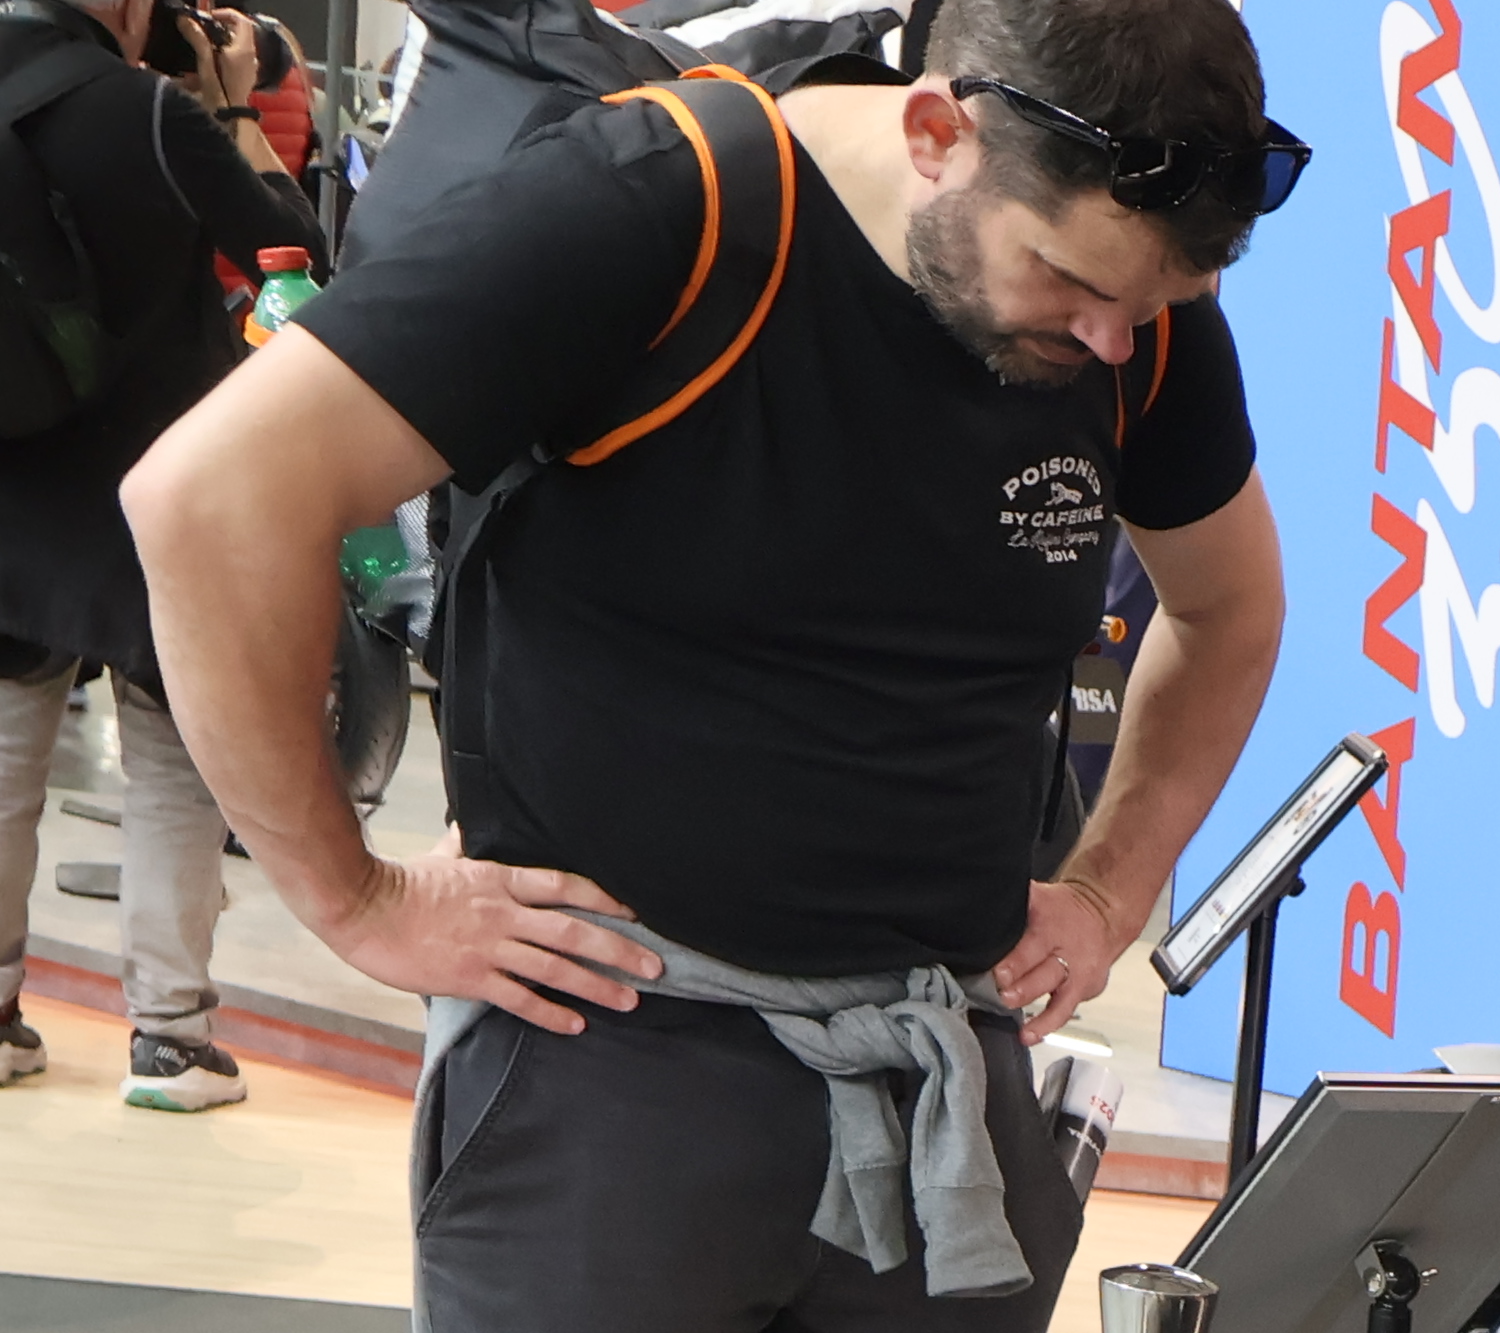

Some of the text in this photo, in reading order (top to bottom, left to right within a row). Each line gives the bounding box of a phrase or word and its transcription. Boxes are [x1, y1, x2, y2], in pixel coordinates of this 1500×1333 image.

[1002, 457, 1101, 501] POISONED
[1000, 511, 1029, 526] BY
[1046, 549, 1078, 564] 2014
